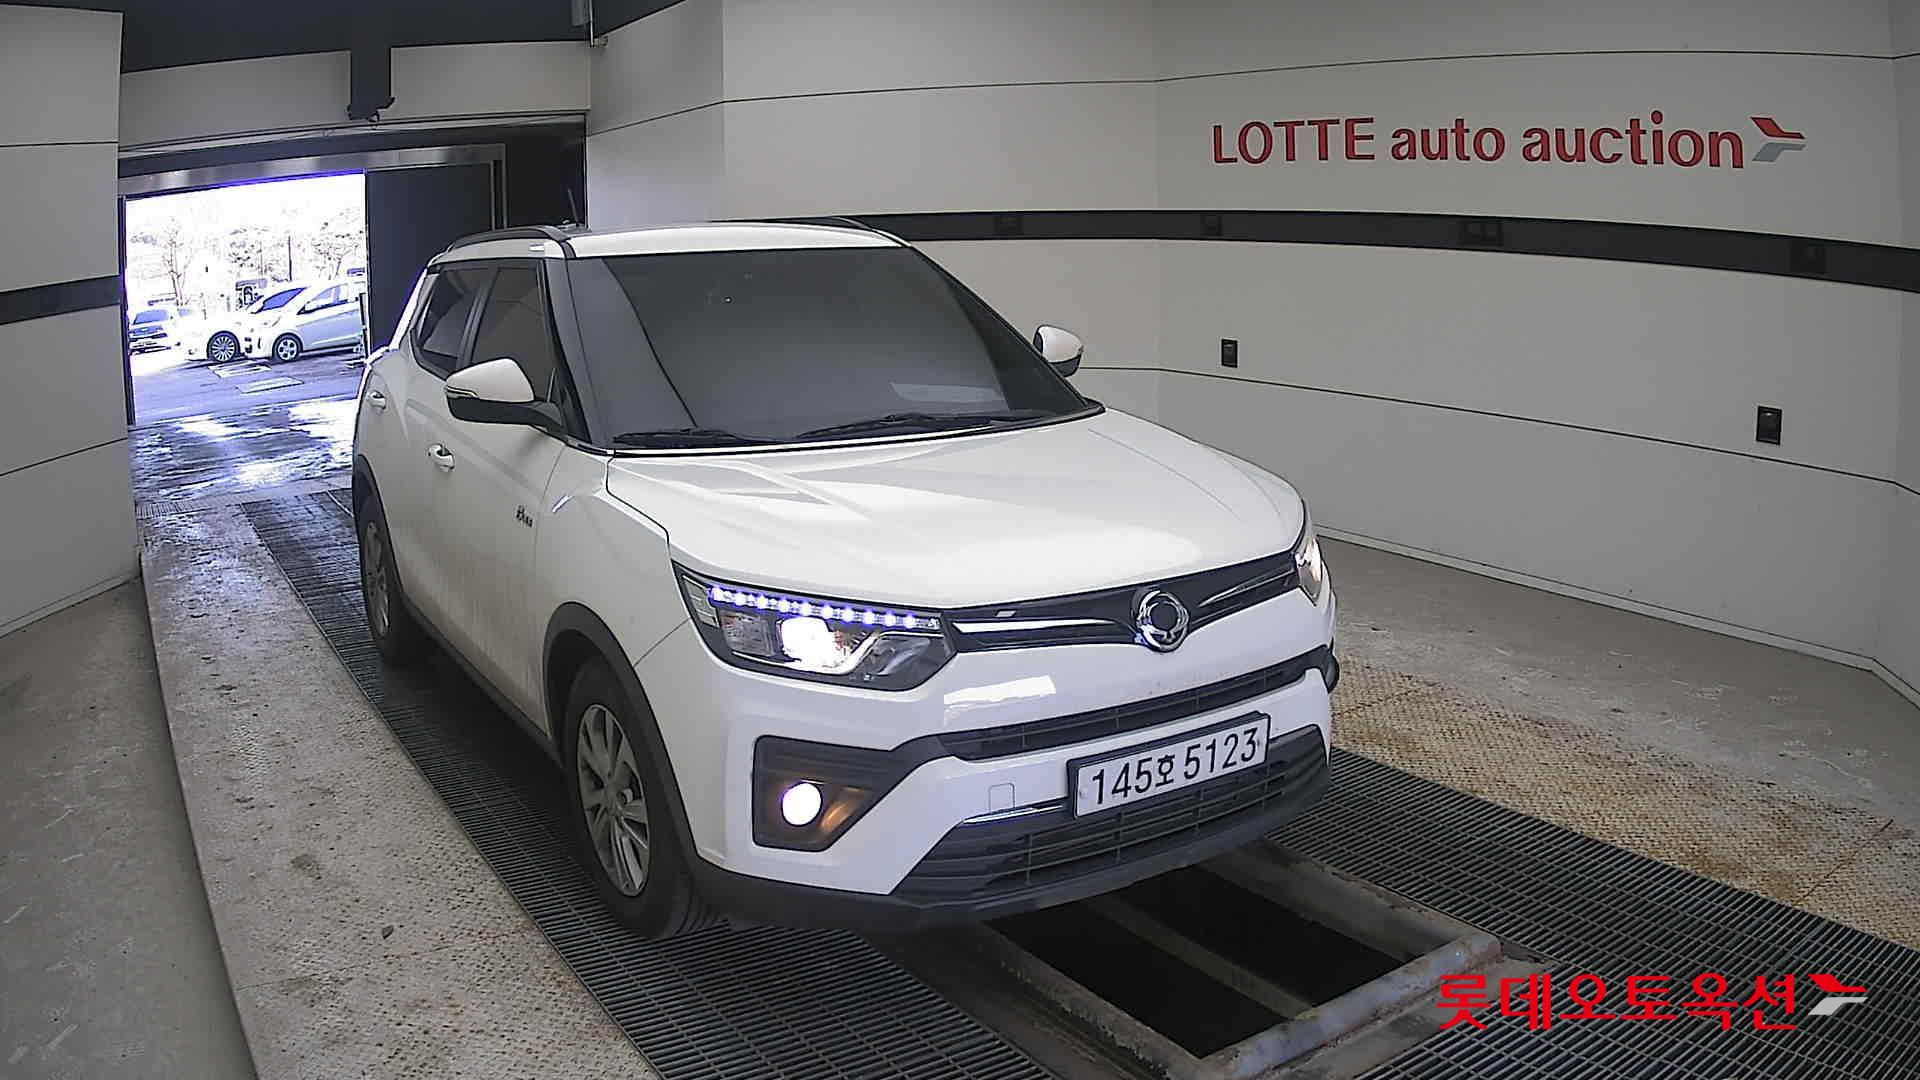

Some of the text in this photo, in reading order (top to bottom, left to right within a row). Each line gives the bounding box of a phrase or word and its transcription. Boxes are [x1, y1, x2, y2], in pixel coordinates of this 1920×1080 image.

[1213, 110, 1744, 169] LOTTE auto auction
[1184, 727, 1258, 779] 5123
